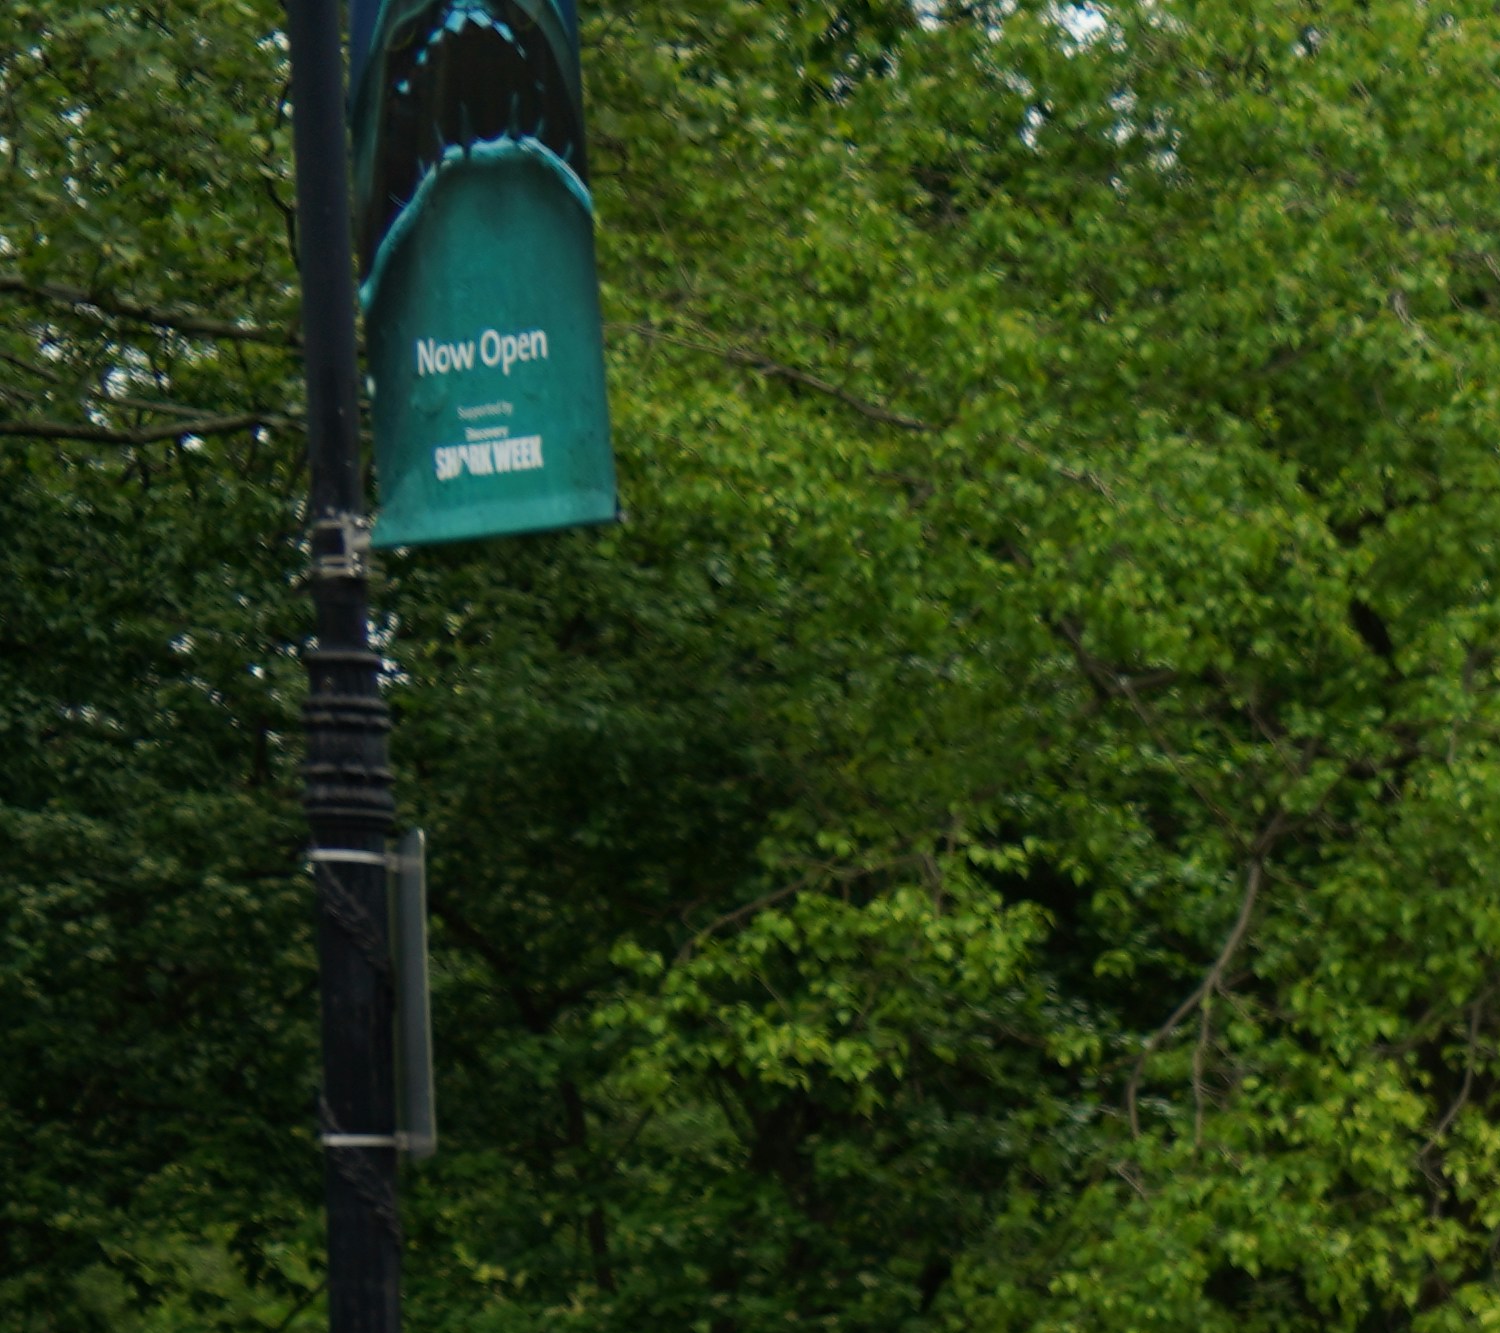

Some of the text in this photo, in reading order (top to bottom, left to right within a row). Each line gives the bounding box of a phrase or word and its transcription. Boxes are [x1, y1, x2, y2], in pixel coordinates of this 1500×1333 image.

[417, 329, 548, 376] Now Open
[493, 435, 543, 473] WEEK
